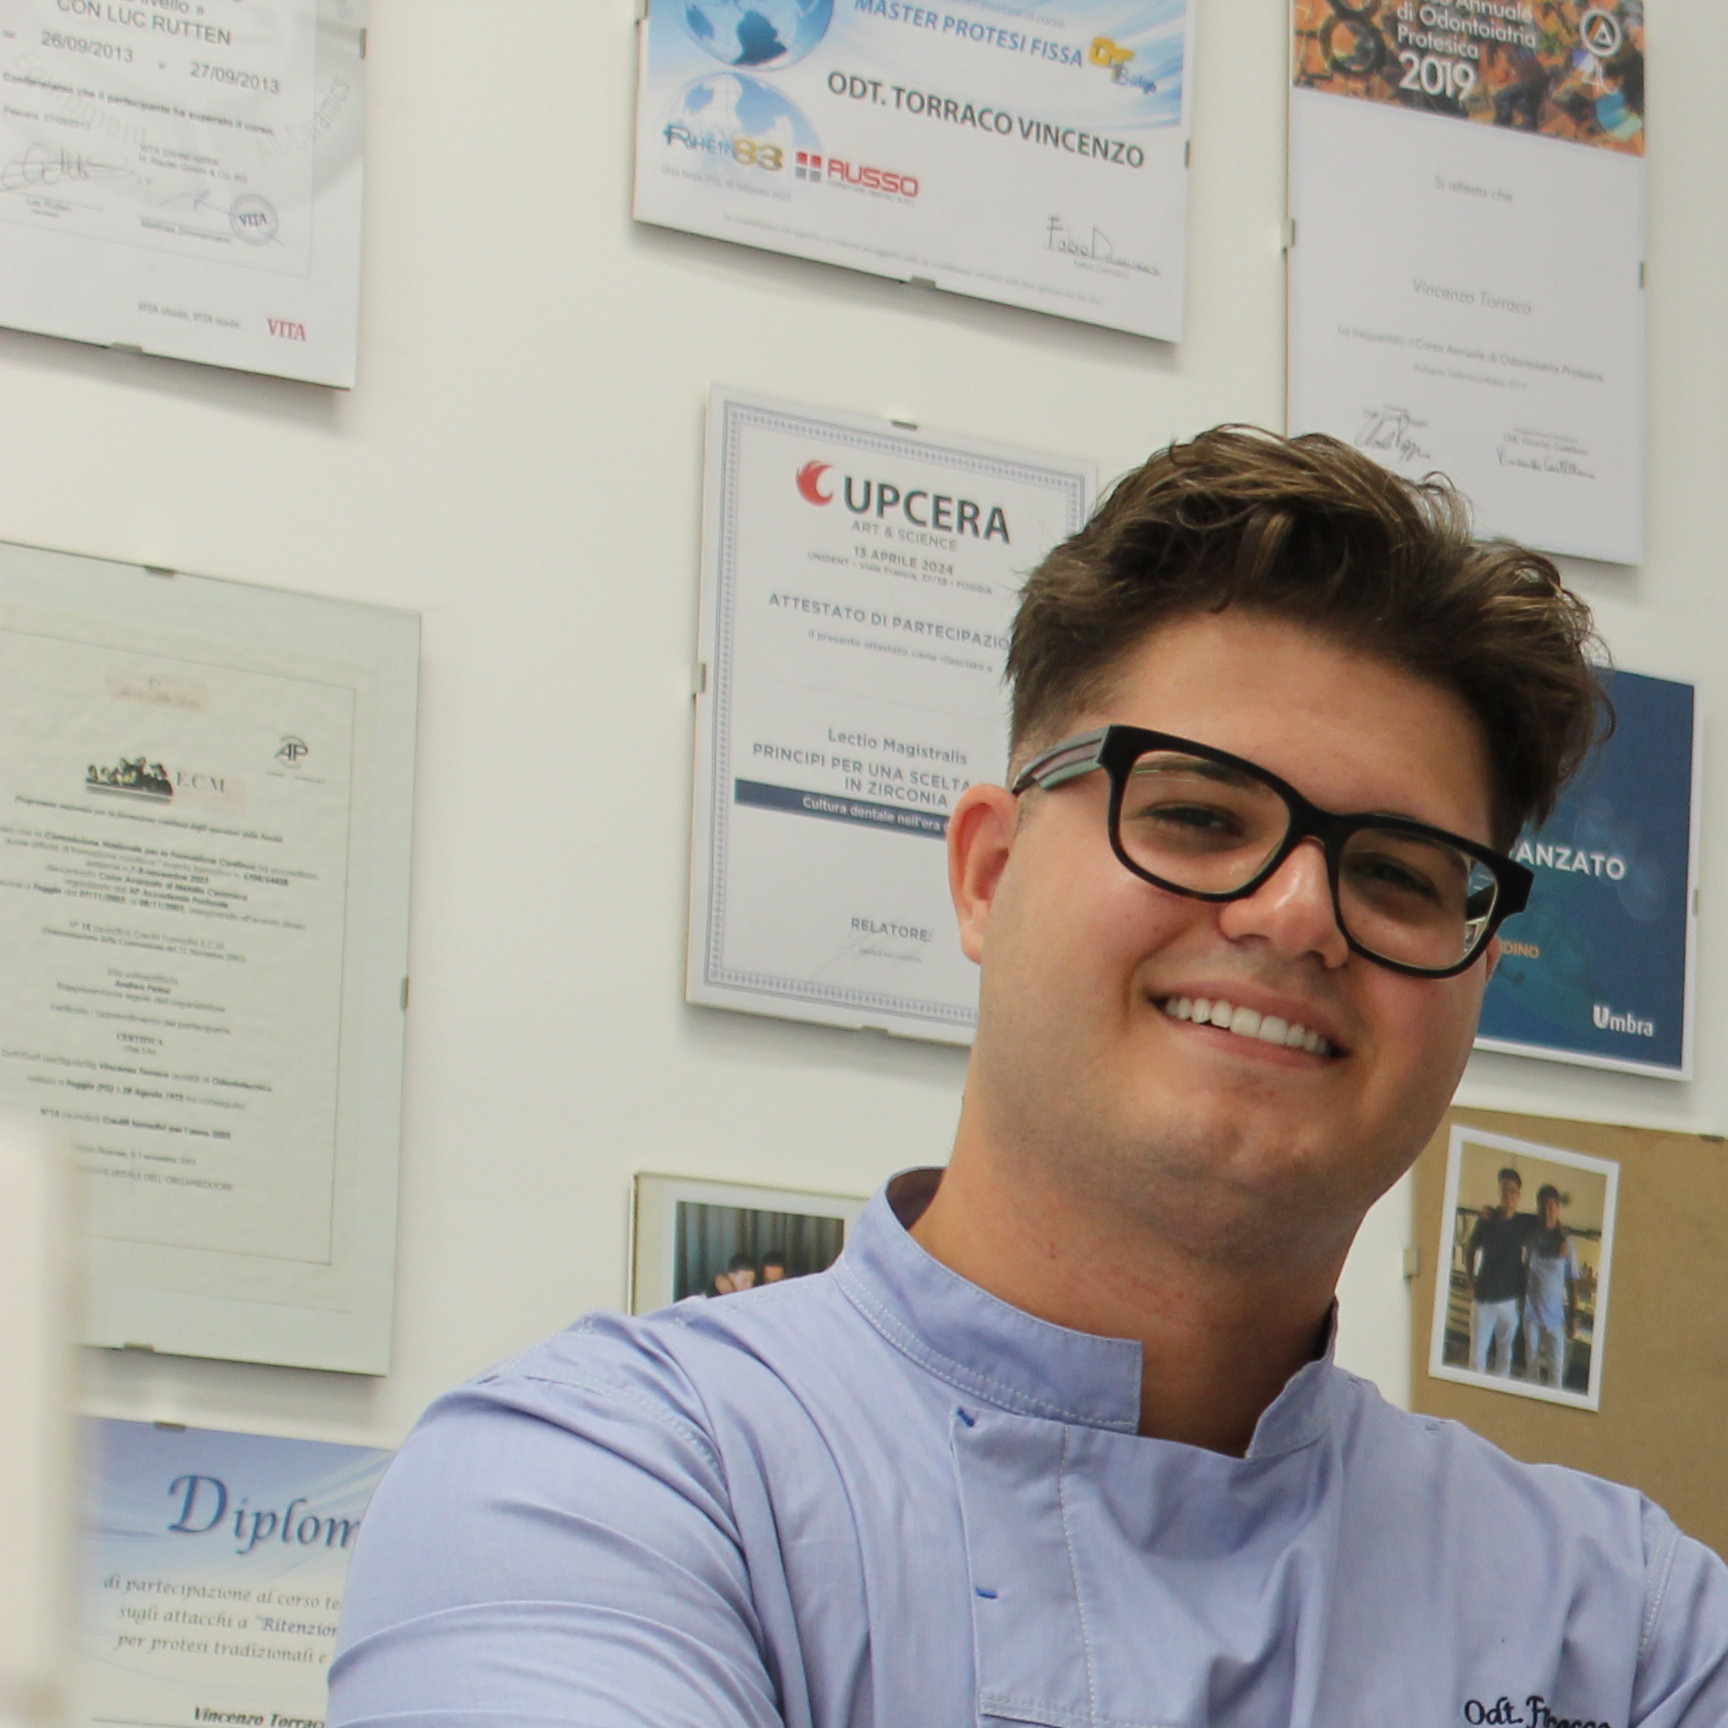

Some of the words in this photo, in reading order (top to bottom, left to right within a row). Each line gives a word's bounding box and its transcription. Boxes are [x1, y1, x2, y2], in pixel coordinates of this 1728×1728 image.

[57, 0, 100, 18] CON
[107, 5, 146, 28] LUC
[152, 14, 231, 46] RUTTEN
[854, 0, 938, 31] MASTER
[943, 15, 1026, 54] PROTESI
[1030, 37, 1083, 69] FISSA
[1419, 6, 1537, 49] Odontoiatria
[1397, 23, 1479, 60] Protesica
[41, 30, 134, 63] 26/09/2013
[190, 61, 280, 94] 27/09/2013
[1398, 50, 1477, 102] 2019
[827, 70, 887, 106] ODT.
[892, 84, 1013, 136] TORRACO
[1017, 115, 1145, 169] VINCENZO
[827, 157, 919, 199] RUSSO
[239, 212, 268, 228] VITA
[1412, 276, 1475, 305] Vincenzo
[1480, 291, 1532, 316] Torraco
[267, 317, 308, 342] VITA
[843, 474, 1012, 547] UPCERA
[851, 519, 880, 537] ART
[884, 525, 894, 539] &
[897, 528, 959, 552] SCIENCE
[870, 549, 918, 570] APRILE
[921, 558, 954, 576] 2024
[768, 592, 866, 624] ATTESTATO
[871, 611, 888, 628] DI
[817, 631, 861, 650] presente
[864, 639, 908, 657] attestato
[911, 648, 937, 663] viene
[827, 727, 878, 750] Lectio
[883, 736, 968, 766] Magistralis
[752, 742, 825, 768] PRINCIPI
[831, 756, 863, 775] PER
[868, 763, 904, 782] UNA
[909, 770, 972, 794] SCELTA
[802, 795, 847, 815] Cultura
[849, 805, 895, 825] dentale
[844, 776, 862, 793] IN
[867, 780, 949, 808] ZIRCONIA
[851, 916, 933, 944] RELATORE:
[1592, 1003, 1655, 1038] Umbra
[103, 1573, 120, 1591] di
[124, 1576, 252, 1602] partecipazione
[256, 1588, 273, 1605] al
[276, 1594, 320, 1609] corso
[119, 1604, 158, 1625] sugli
[163, 1607, 233, 1629] attacchi
[236, 1617, 249, 1630] a
[115, 1631, 145, 1649] per
[148, 1634, 209, 1655] protesi
[213, 1640, 314, 1664] tradizionali
[317, 1651, 328, 1665] e
[194, 1706, 264, 1727] Vincenzo
[1464, 1696, 1524, 1726] Odt.
